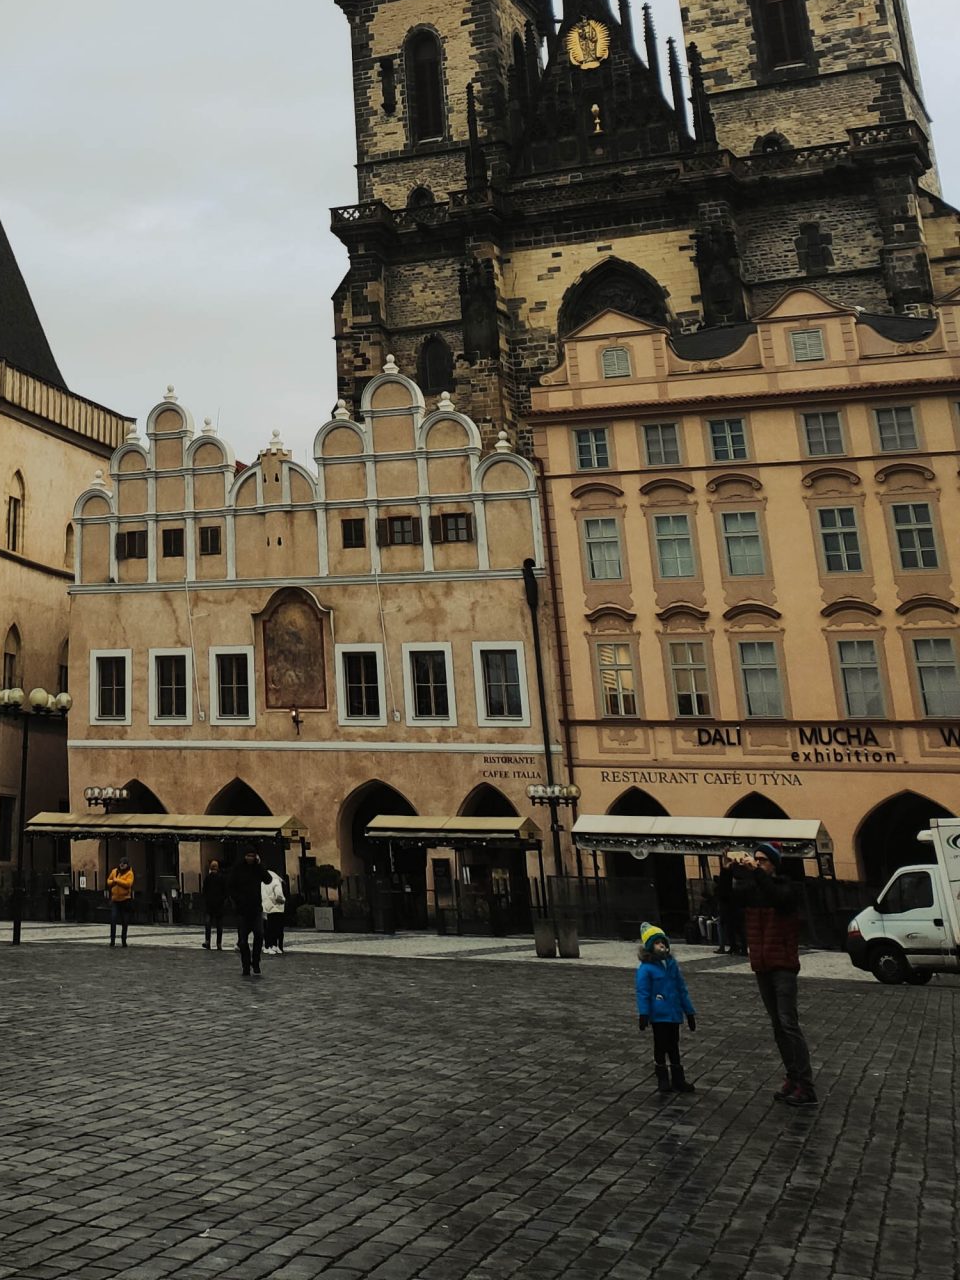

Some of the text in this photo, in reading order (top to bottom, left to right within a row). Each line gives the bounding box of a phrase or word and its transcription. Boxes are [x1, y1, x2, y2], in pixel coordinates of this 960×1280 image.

[799, 727, 879, 747] MUCHA
[483, 756, 536, 765] RISTORANTE
[791, 748, 897, 763] exhibition
[513, 771, 542, 780] ITALIA
[601, 770, 803, 787] RESTAURANT CAFÉ U TÝNA
